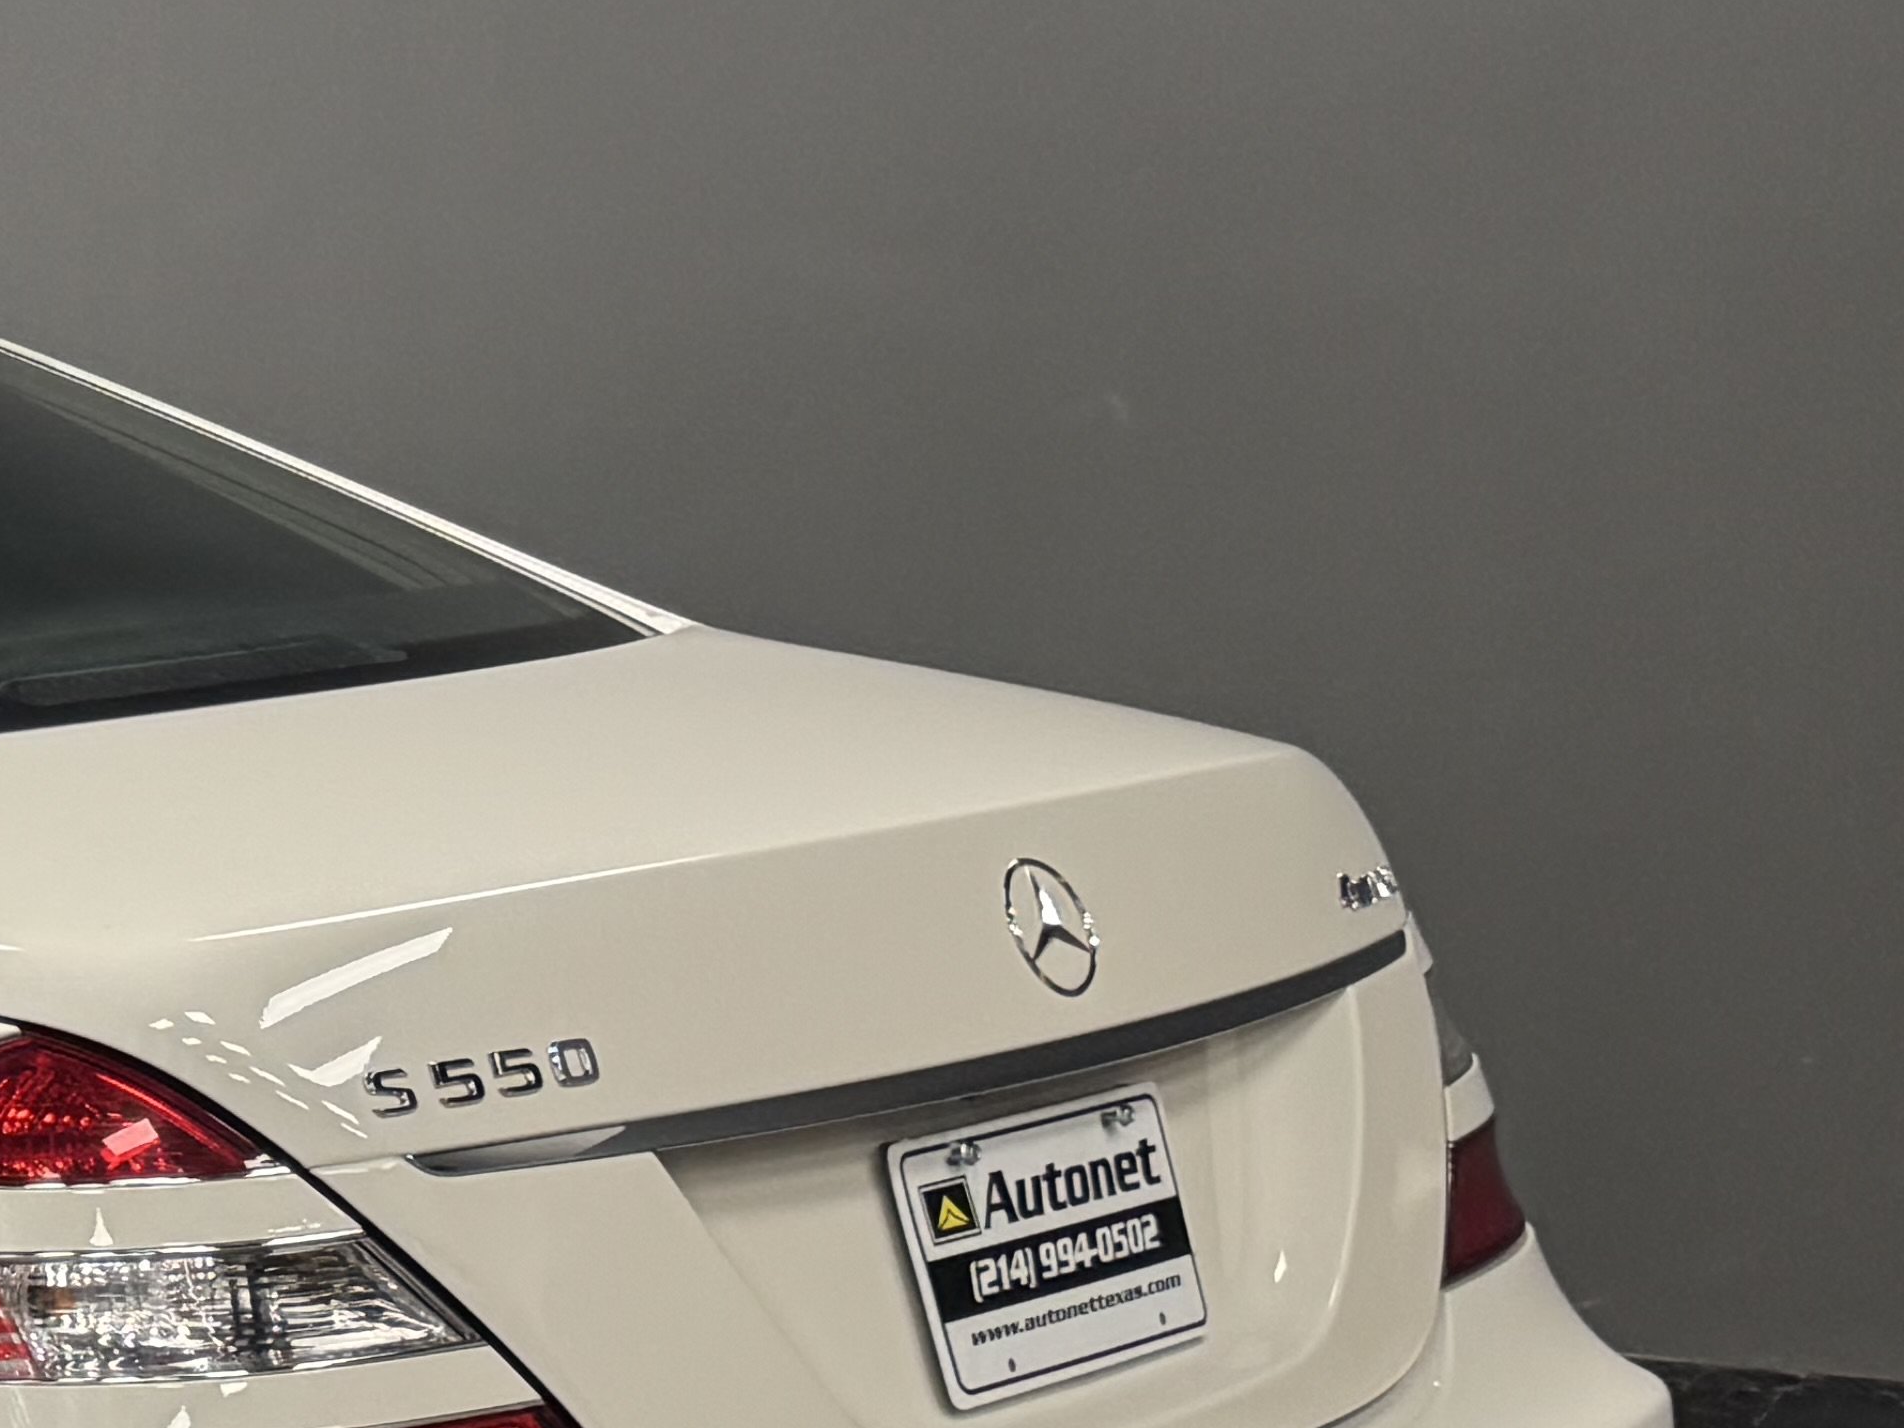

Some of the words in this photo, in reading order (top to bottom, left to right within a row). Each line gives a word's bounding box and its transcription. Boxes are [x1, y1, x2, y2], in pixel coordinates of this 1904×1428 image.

[984, 1138, 1161, 1230] Autonet
[970, 1246, 1037, 1303] (214)
[1039, 1213, 1161, 1278] 994-0502
[971, 1272, 1182, 1346] www.autonettexas.com
